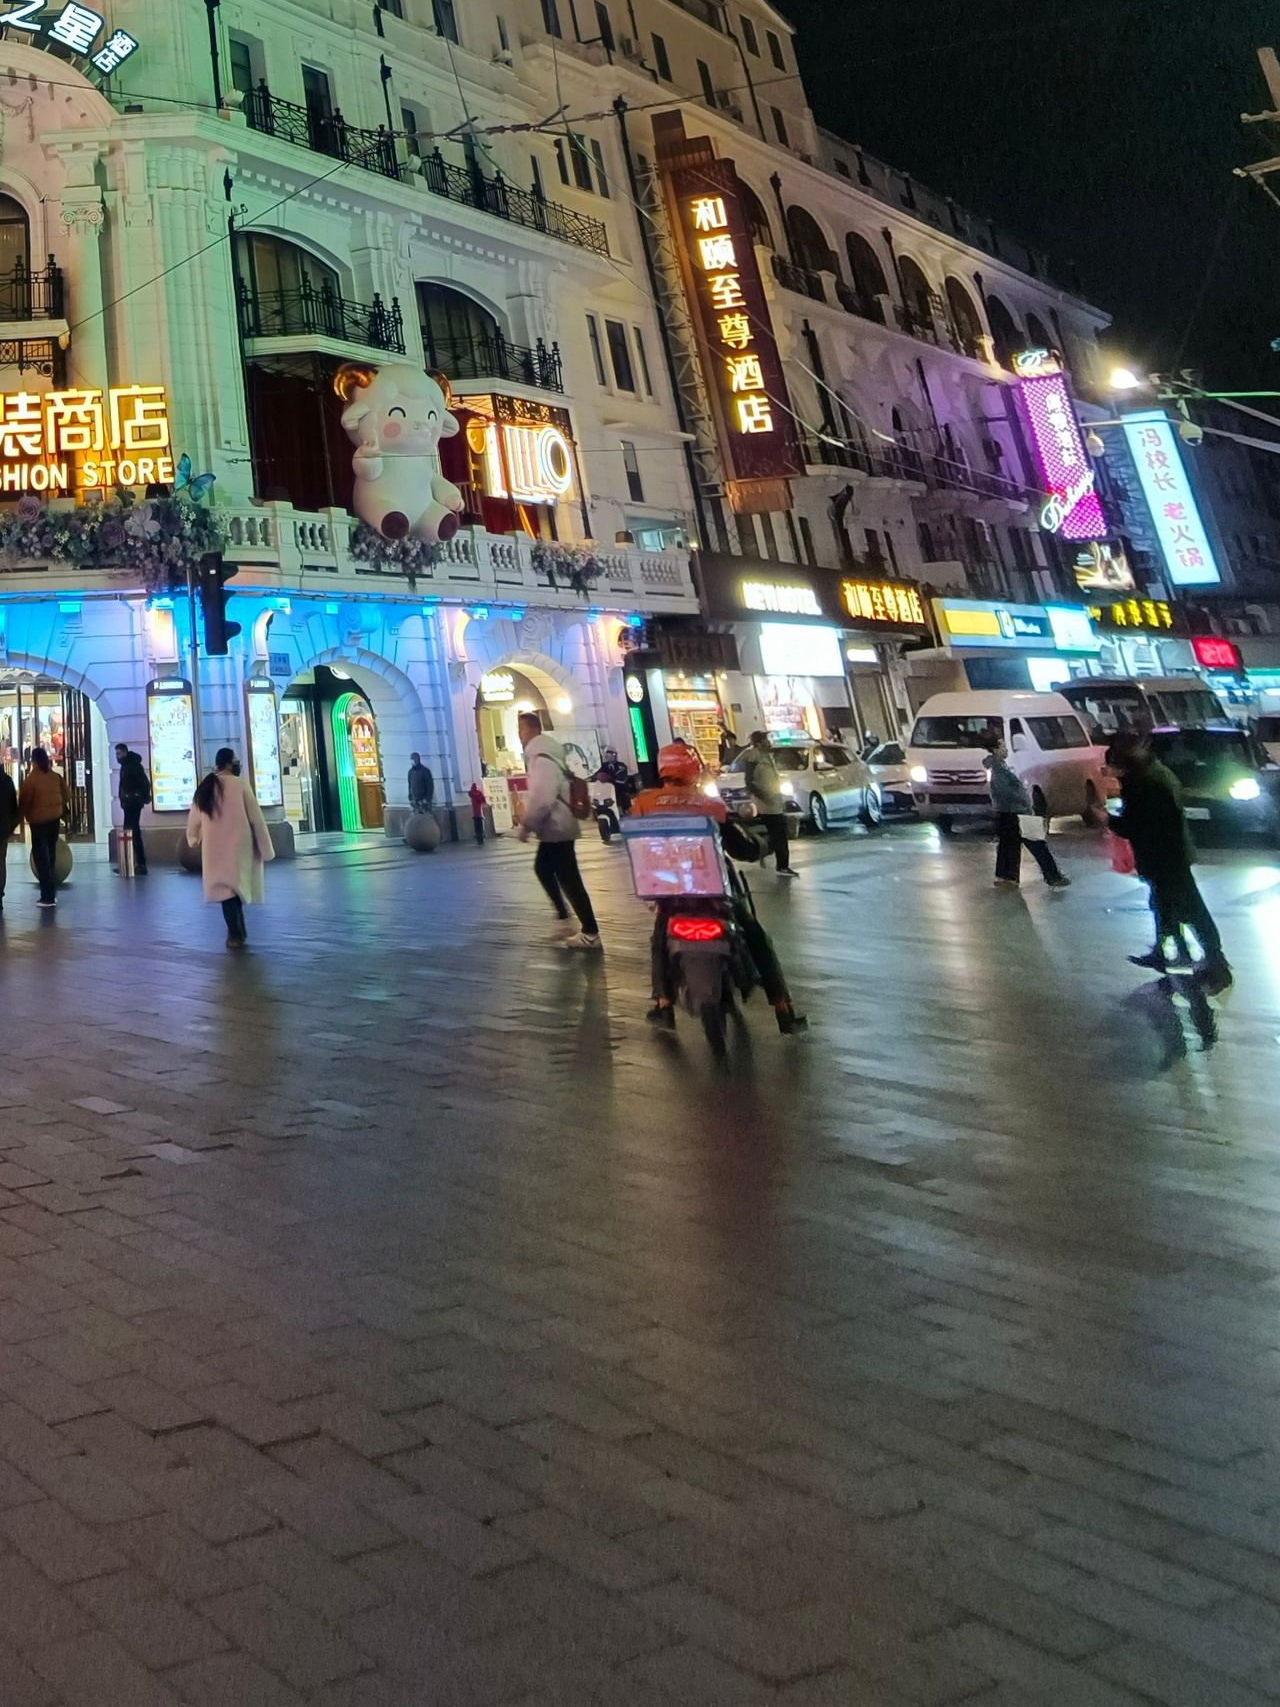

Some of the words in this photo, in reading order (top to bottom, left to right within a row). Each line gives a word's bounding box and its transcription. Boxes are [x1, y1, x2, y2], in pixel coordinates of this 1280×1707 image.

[90, 29, 138, 76] 酒店
[691, 196, 774, 435] 和颐至尊酒店
[82, 455, 175, 487] STORE
[842, 580, 925, 624] 和颐至尊酒店
